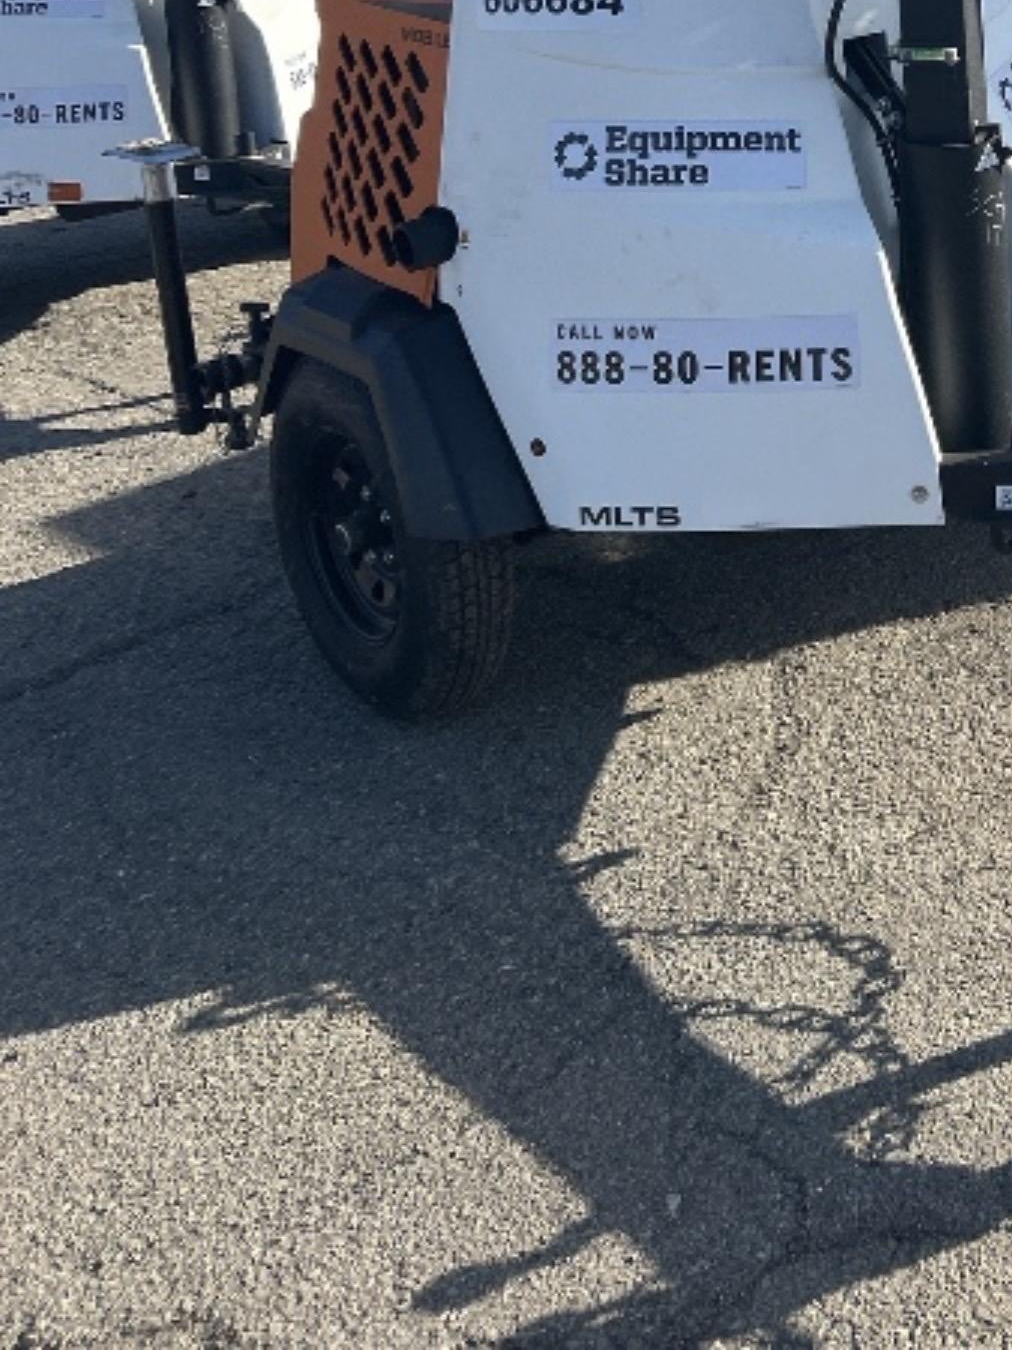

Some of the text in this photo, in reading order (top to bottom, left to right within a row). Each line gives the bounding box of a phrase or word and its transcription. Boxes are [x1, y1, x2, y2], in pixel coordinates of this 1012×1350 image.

[0, 0, 48, 15] hare
[605, 125, 802, 159] Equipment
[605, 158, 709, 186] Share
[557, 323, 655, 340] CALL NOW
[557, 347, 853, 385] 888-80-RENTS
